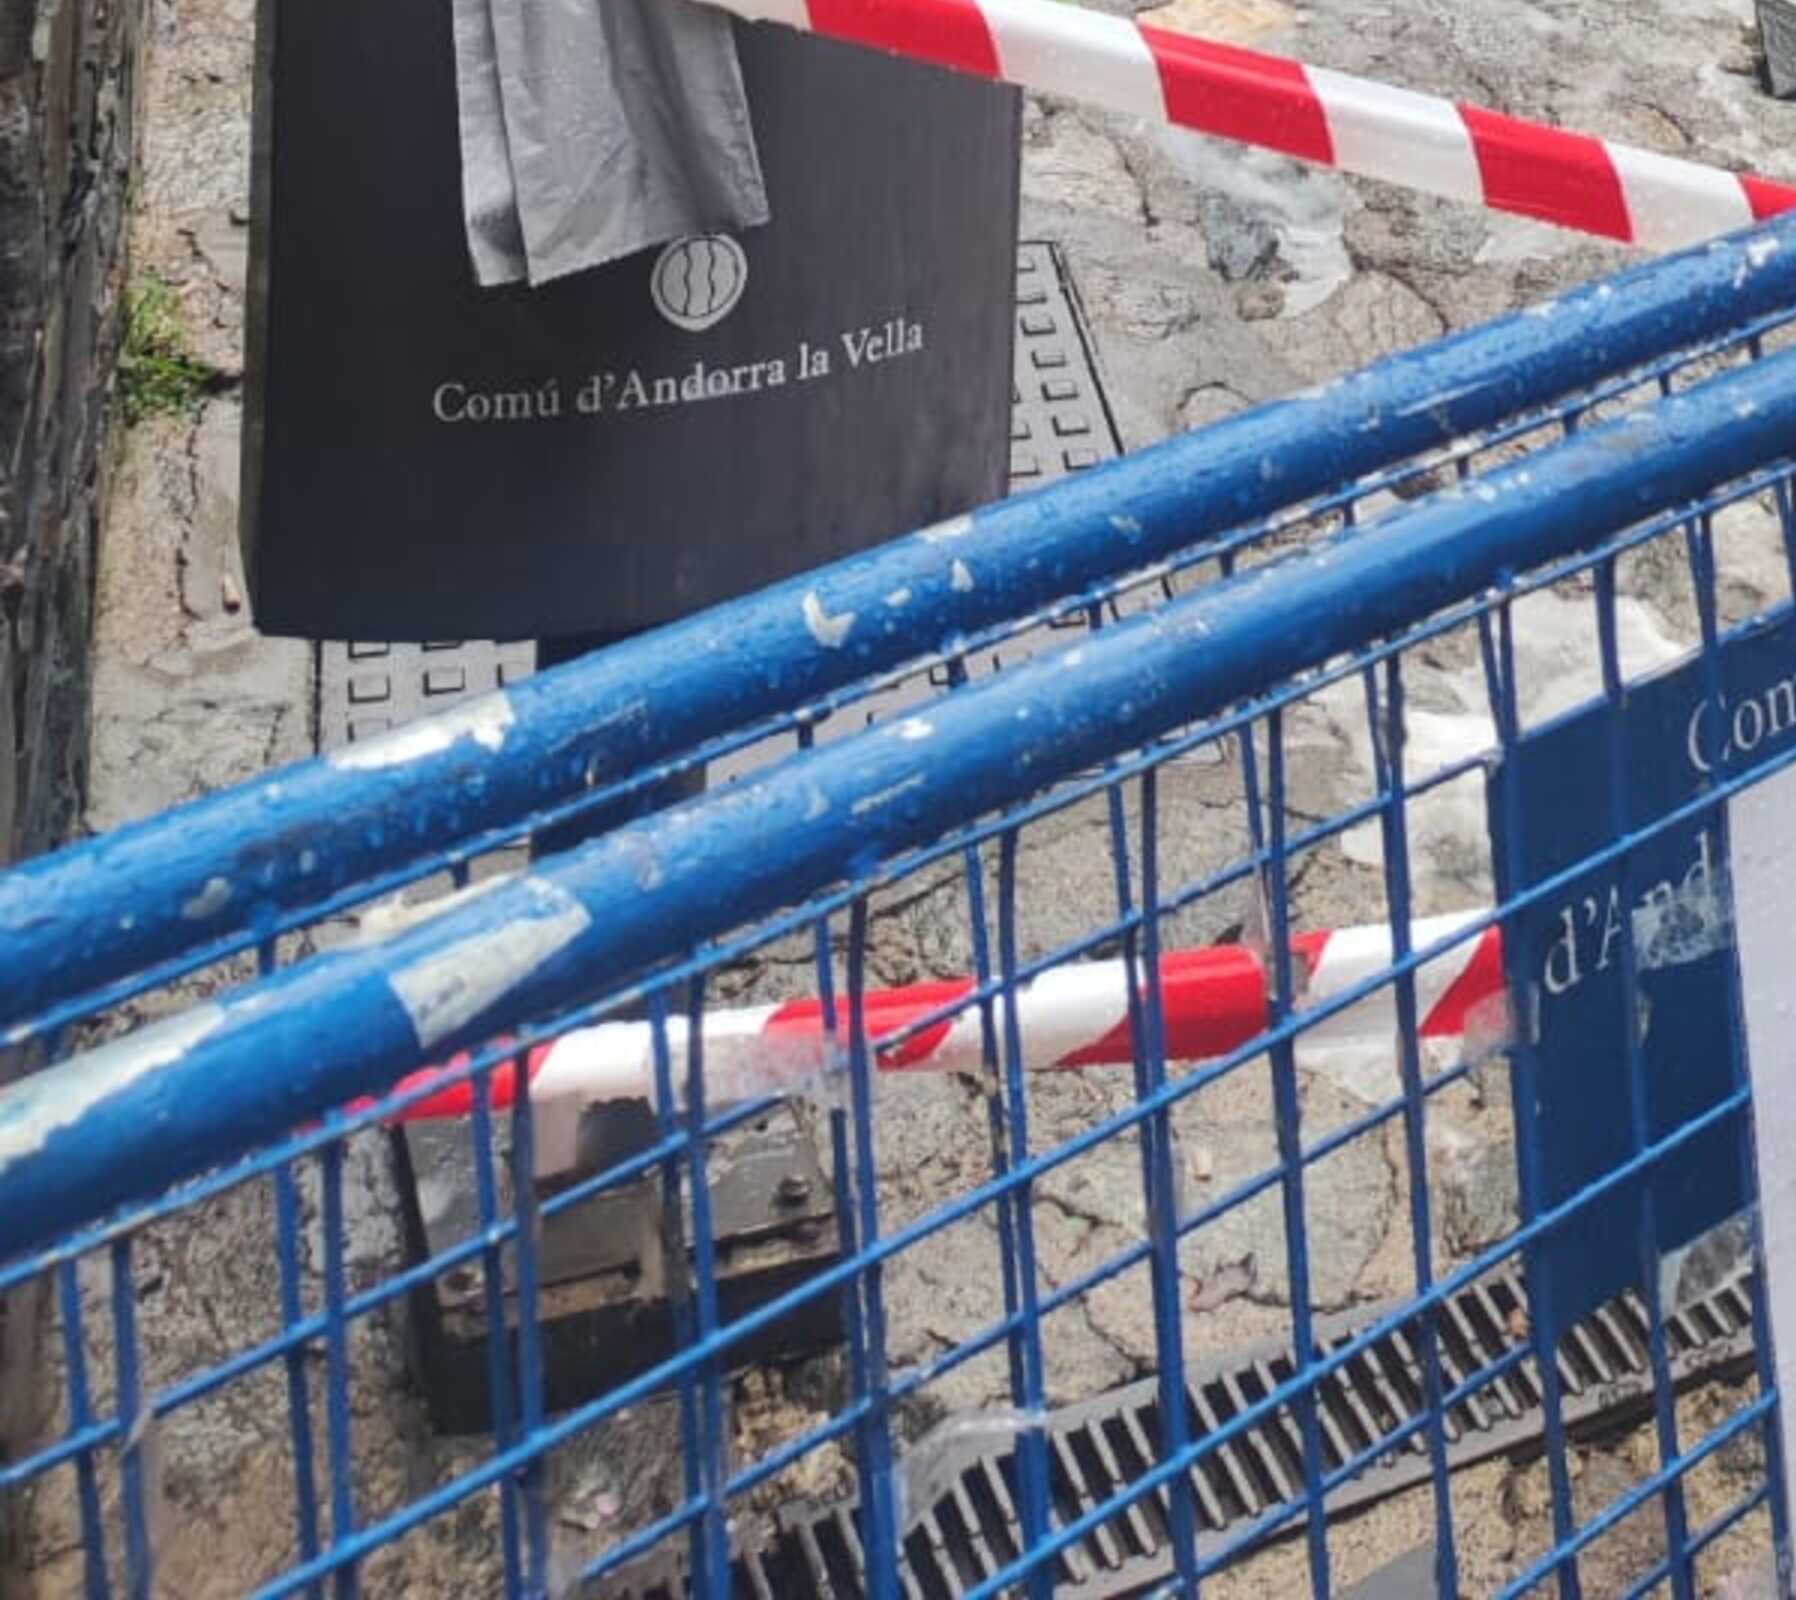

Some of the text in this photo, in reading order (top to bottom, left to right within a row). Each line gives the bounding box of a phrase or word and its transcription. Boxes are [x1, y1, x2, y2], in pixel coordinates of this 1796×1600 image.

[433, 318, 924, 423] Comú d'Andorra la Vella
